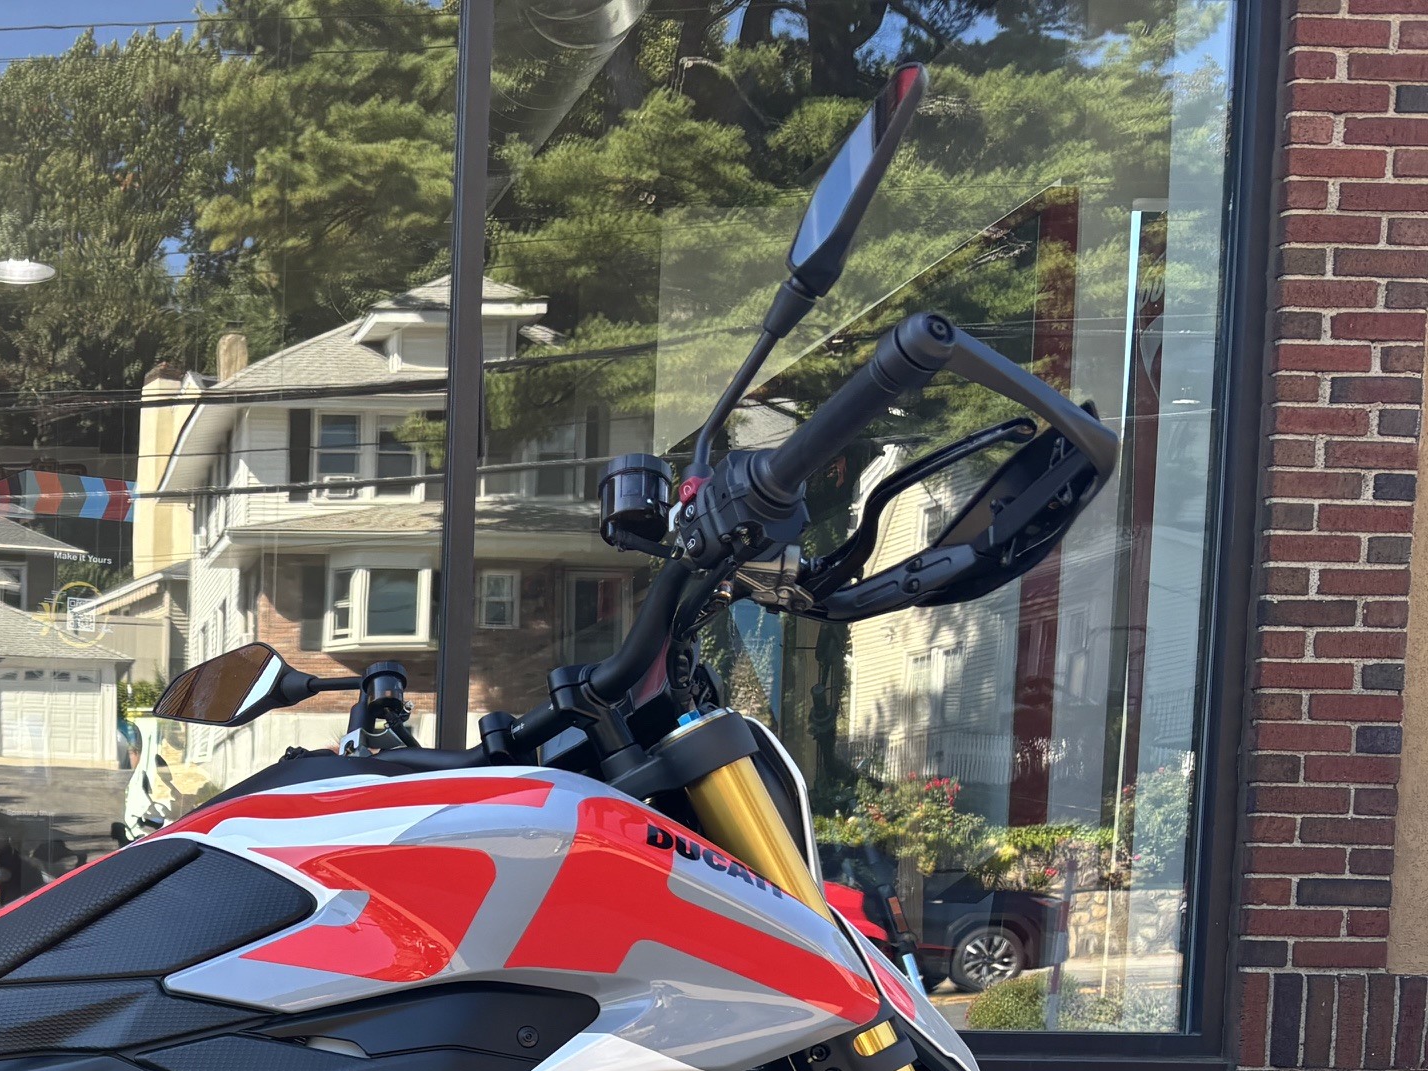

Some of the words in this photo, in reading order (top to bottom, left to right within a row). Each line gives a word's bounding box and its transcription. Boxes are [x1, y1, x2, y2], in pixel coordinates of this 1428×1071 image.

[54, 552, 77, 561] Make
[79, 554, 86, 562] it
[87, 555, 112, 564] Yours
[646, 824, 783, 899] DUCATI
